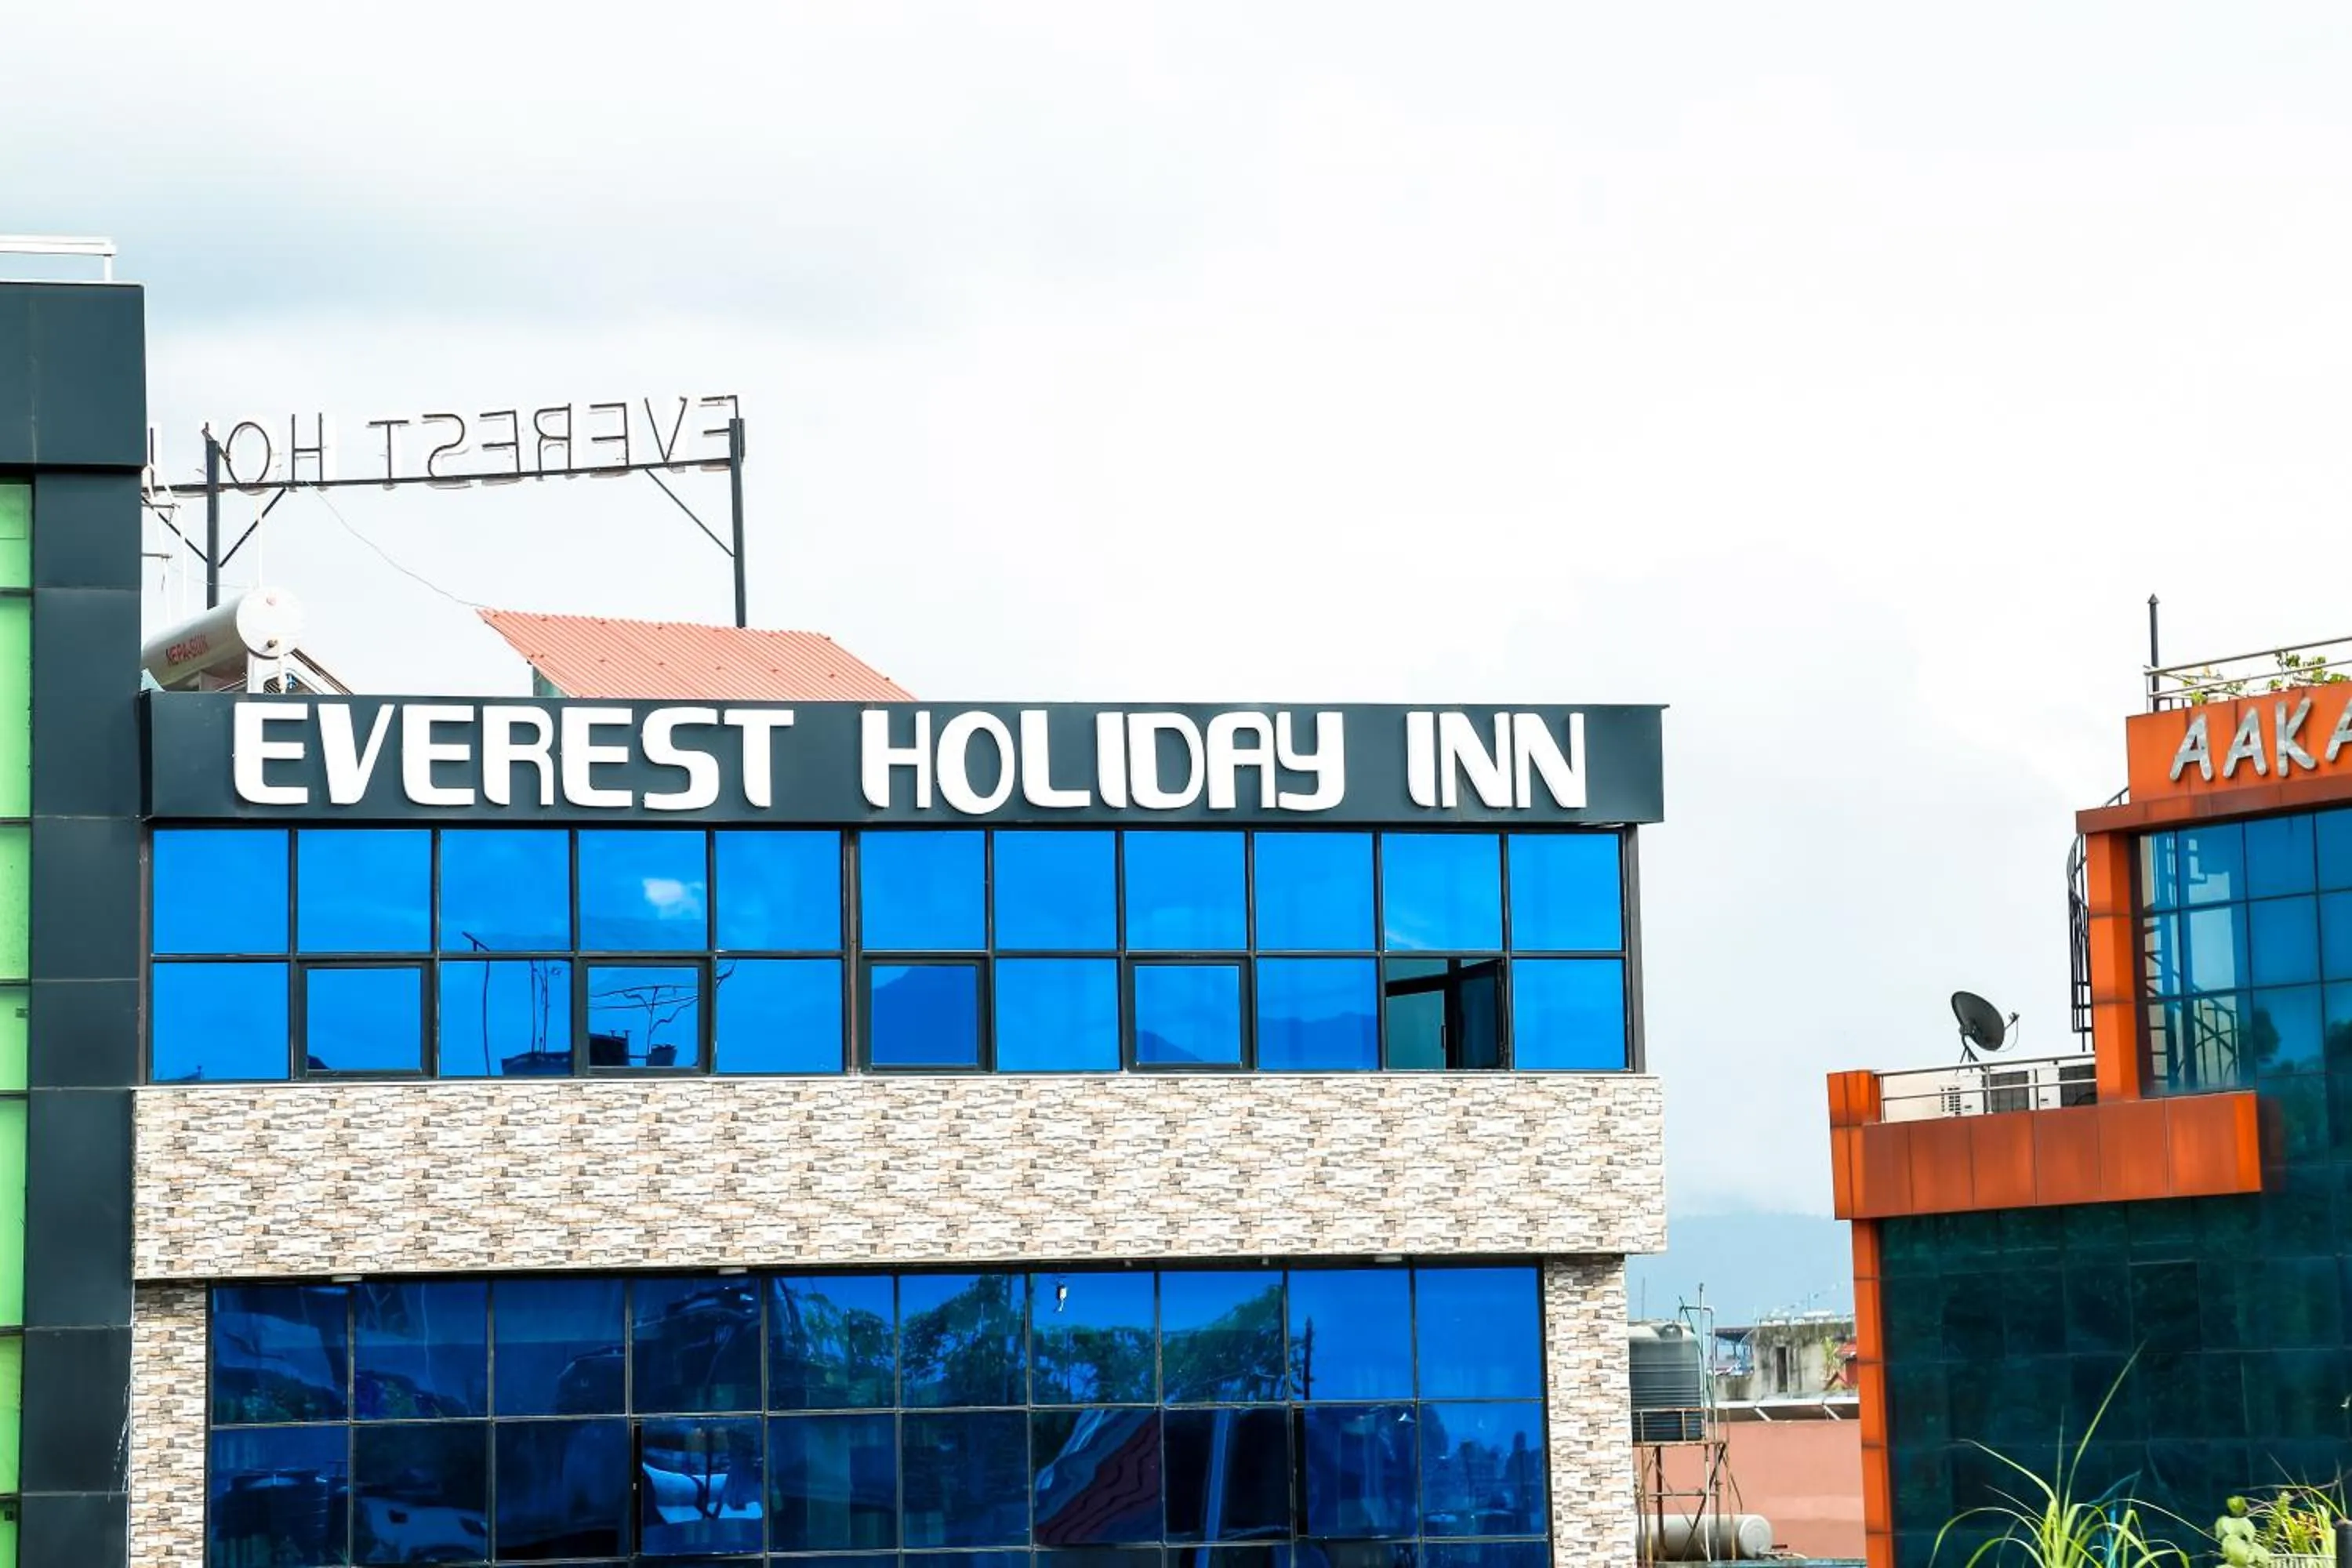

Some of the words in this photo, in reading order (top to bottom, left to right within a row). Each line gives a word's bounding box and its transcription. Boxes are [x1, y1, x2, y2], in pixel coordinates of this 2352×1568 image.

[234, 702, 794, 811] EVEREST
[862, 710, 1345, 814] HOLIDAY
[1406, 711, 1587, 808] INN
